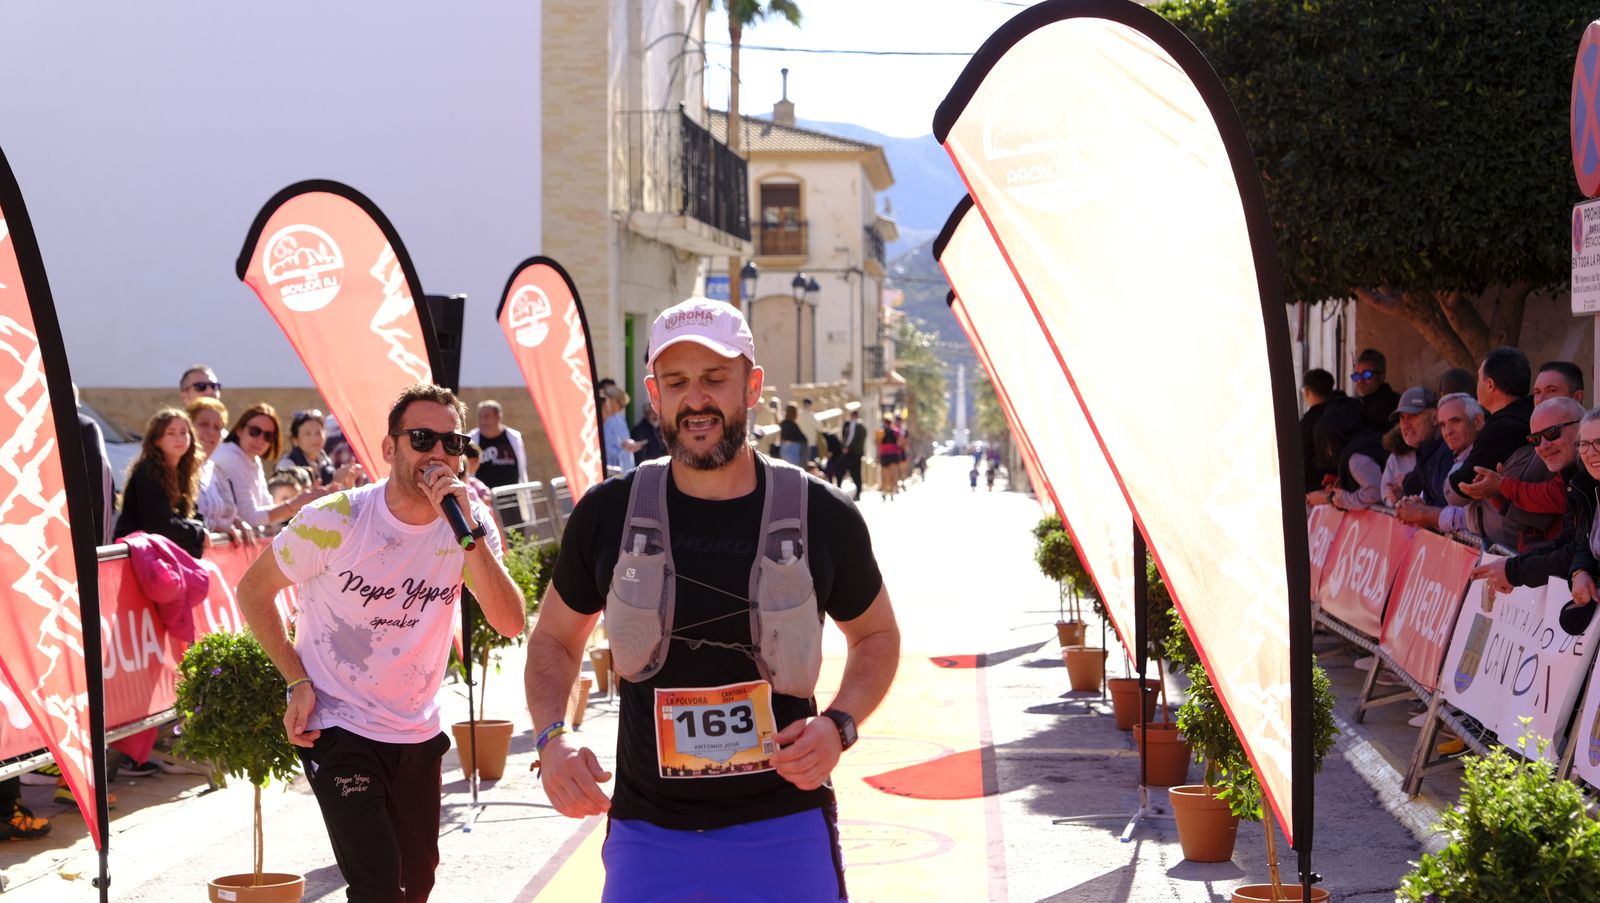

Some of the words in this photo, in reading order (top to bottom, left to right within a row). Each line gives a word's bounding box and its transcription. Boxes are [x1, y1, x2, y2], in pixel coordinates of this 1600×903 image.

[679, 310, 713, 321] ROMA
[339, 570, 397, 608] Pepe
[401, 577, 458, 613] Yepes
[1346, 545, 1387, 608] VEOLIA
[1409, 575, 1457, 649] VEOLIA
[103, 607, 165, 680] OLIA
[666, 698, 675, 706] LA
[676, 705, 754, 738] 163
